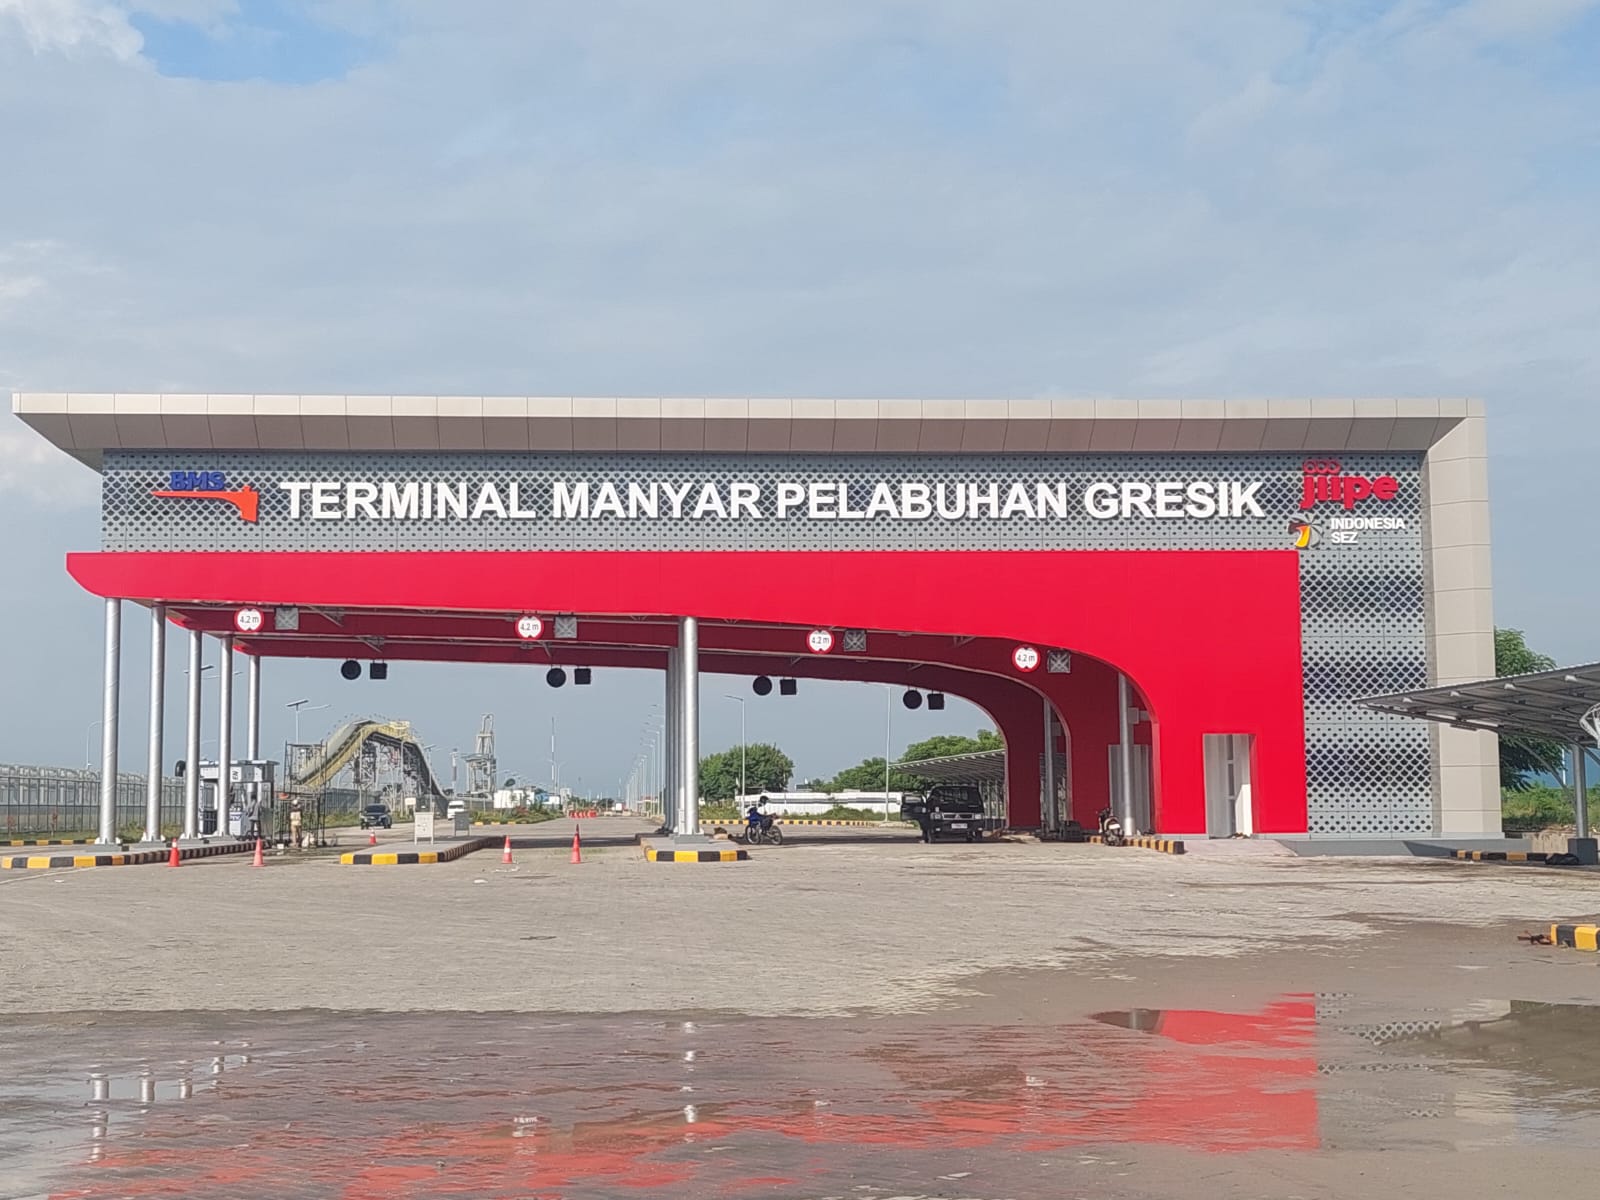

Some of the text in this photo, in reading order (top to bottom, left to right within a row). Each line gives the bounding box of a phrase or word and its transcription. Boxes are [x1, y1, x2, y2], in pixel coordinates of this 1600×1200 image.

[170, 471, 225, 491] BMS
[1299, 458, 1399, 510] jiipe
[279, 480, 1265, 520] TERMINAL MANYAR PELABUHAN GRESIK
[1330, 517, 1406, 530] INDONESIA
[1331, 531, 1359, 544] SEZ
[1017, 654, 1027, 662] 4.2
